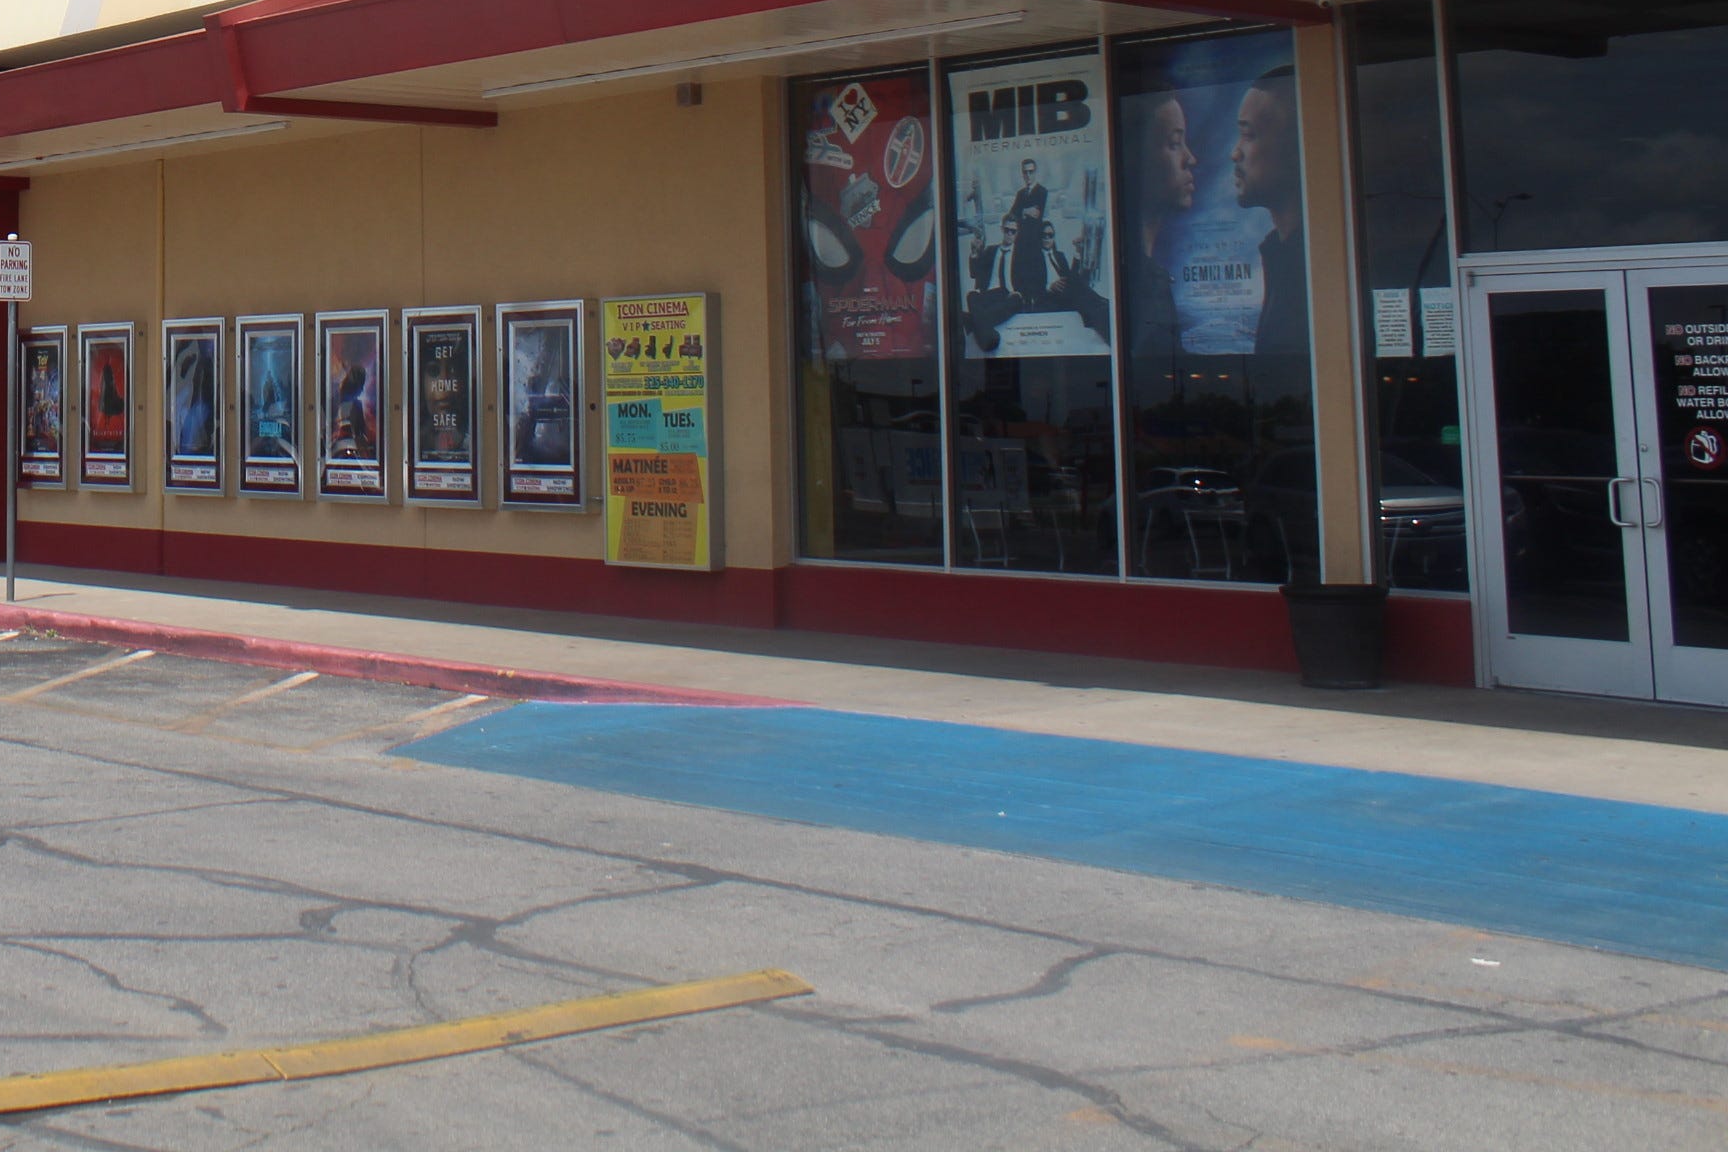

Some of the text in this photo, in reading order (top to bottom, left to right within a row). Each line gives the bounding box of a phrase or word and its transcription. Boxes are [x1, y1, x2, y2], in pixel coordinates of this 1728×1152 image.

[844, 98, 870, 133] NY
[968, 79, 1091, 142] MIB
[8, 247, 20, 257] NO
[0, 259, 28, 270] PARKING
[1224, 263, 1251, 280] MAN
[0, 274, 28, 282] FIRE LANE
[0, 285, 28, 294] TOW ZONE
[617, 301, 689, 319] ICON CINEMA
[651, 320, 686, 330] SEATING
[1687, 336, 1704, 346] OR
[435, 346, 453, 359] GET
[432, 380, 458, 392] HOME
[1676, 397, 1715, 408] WATER
[618, 403, 652, 418] MON.
[433, 414, 457, 426] SAFE
[662, 412, 695, 427] TUES.
[631, 501, 687, 518] EVENING
